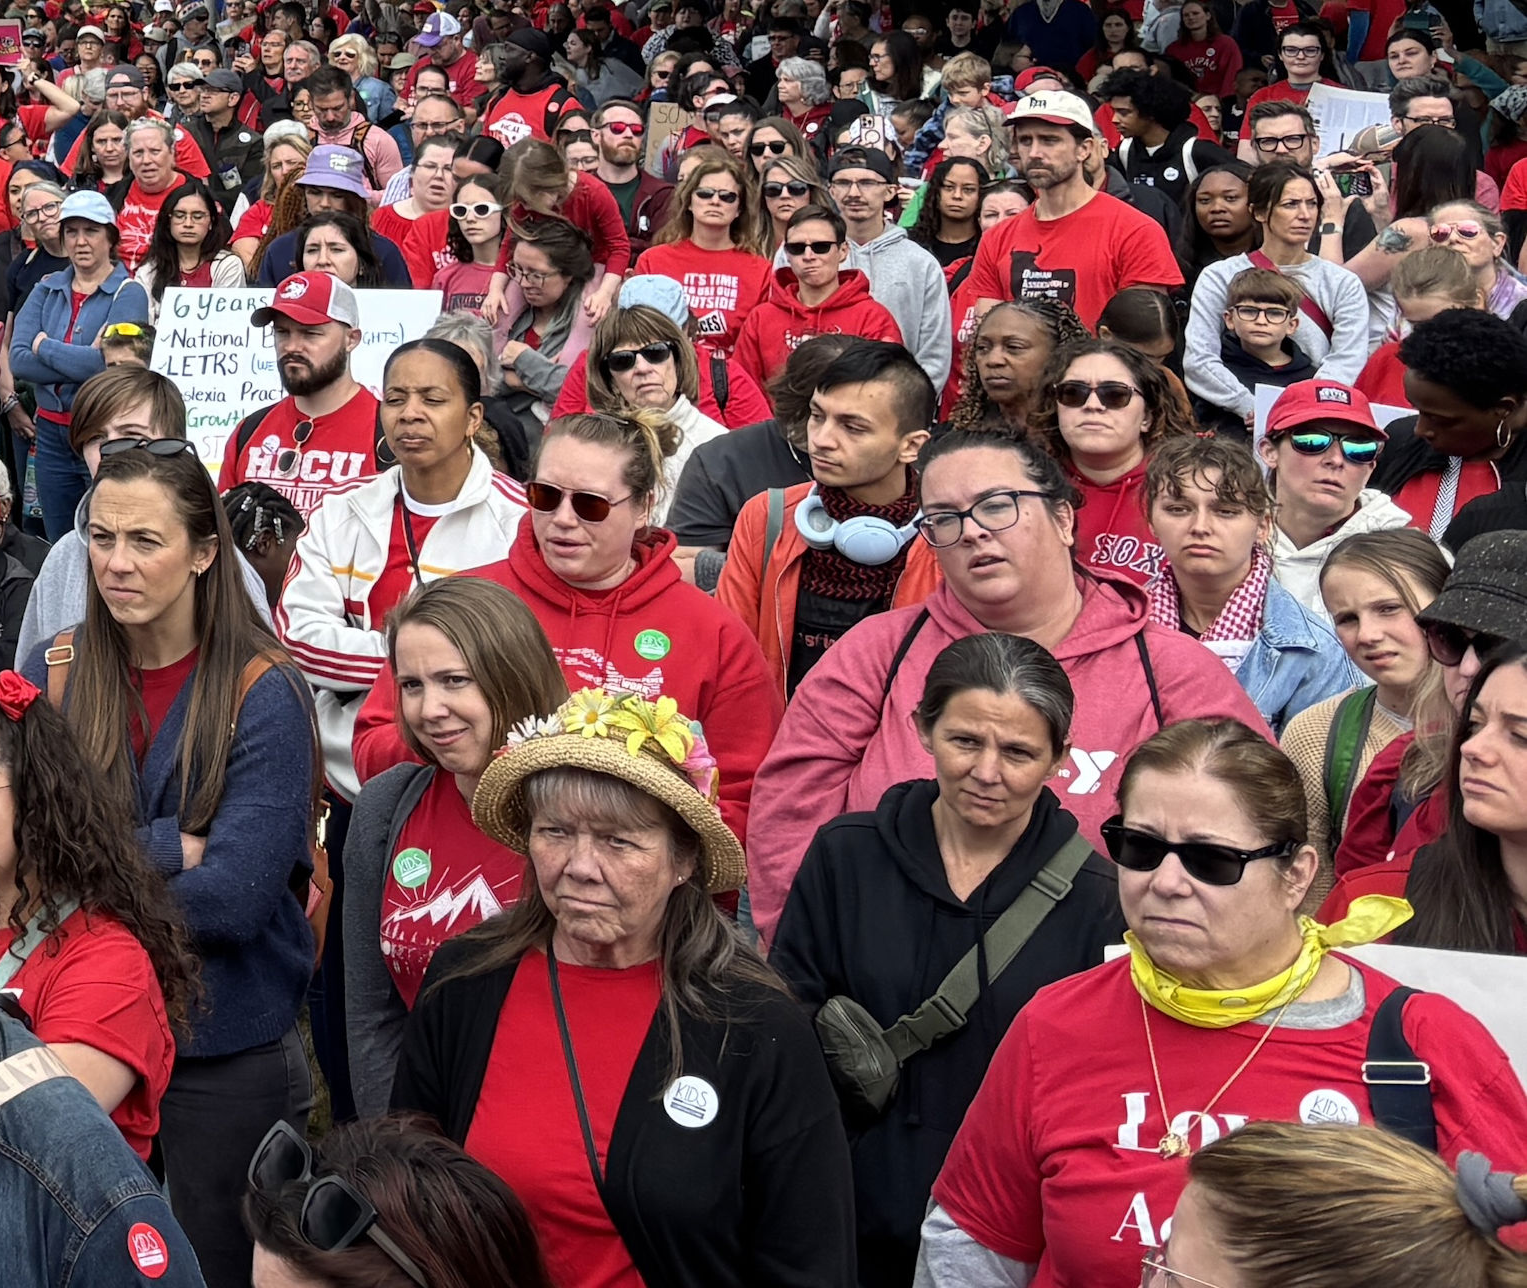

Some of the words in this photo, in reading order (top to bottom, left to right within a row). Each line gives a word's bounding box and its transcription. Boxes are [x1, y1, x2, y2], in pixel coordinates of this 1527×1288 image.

[684, 273, 707, 285] IT'S
[707, 273, 739, 286] TIME
[173, 294, 190, 318] 6
[197, 293, 269, 321] Years
[683, 295, 737, 311] OUTSIDE
[700, 315, 721, 333] CES
[171, 329, 251, 350] National
[166, 352, 239, 377] LETRS
[1091, 532, 1166, 577] SOX
[675, 1081, 708, 1108] KIDS
[1312, 1094, 1348, 1123] KIDS
